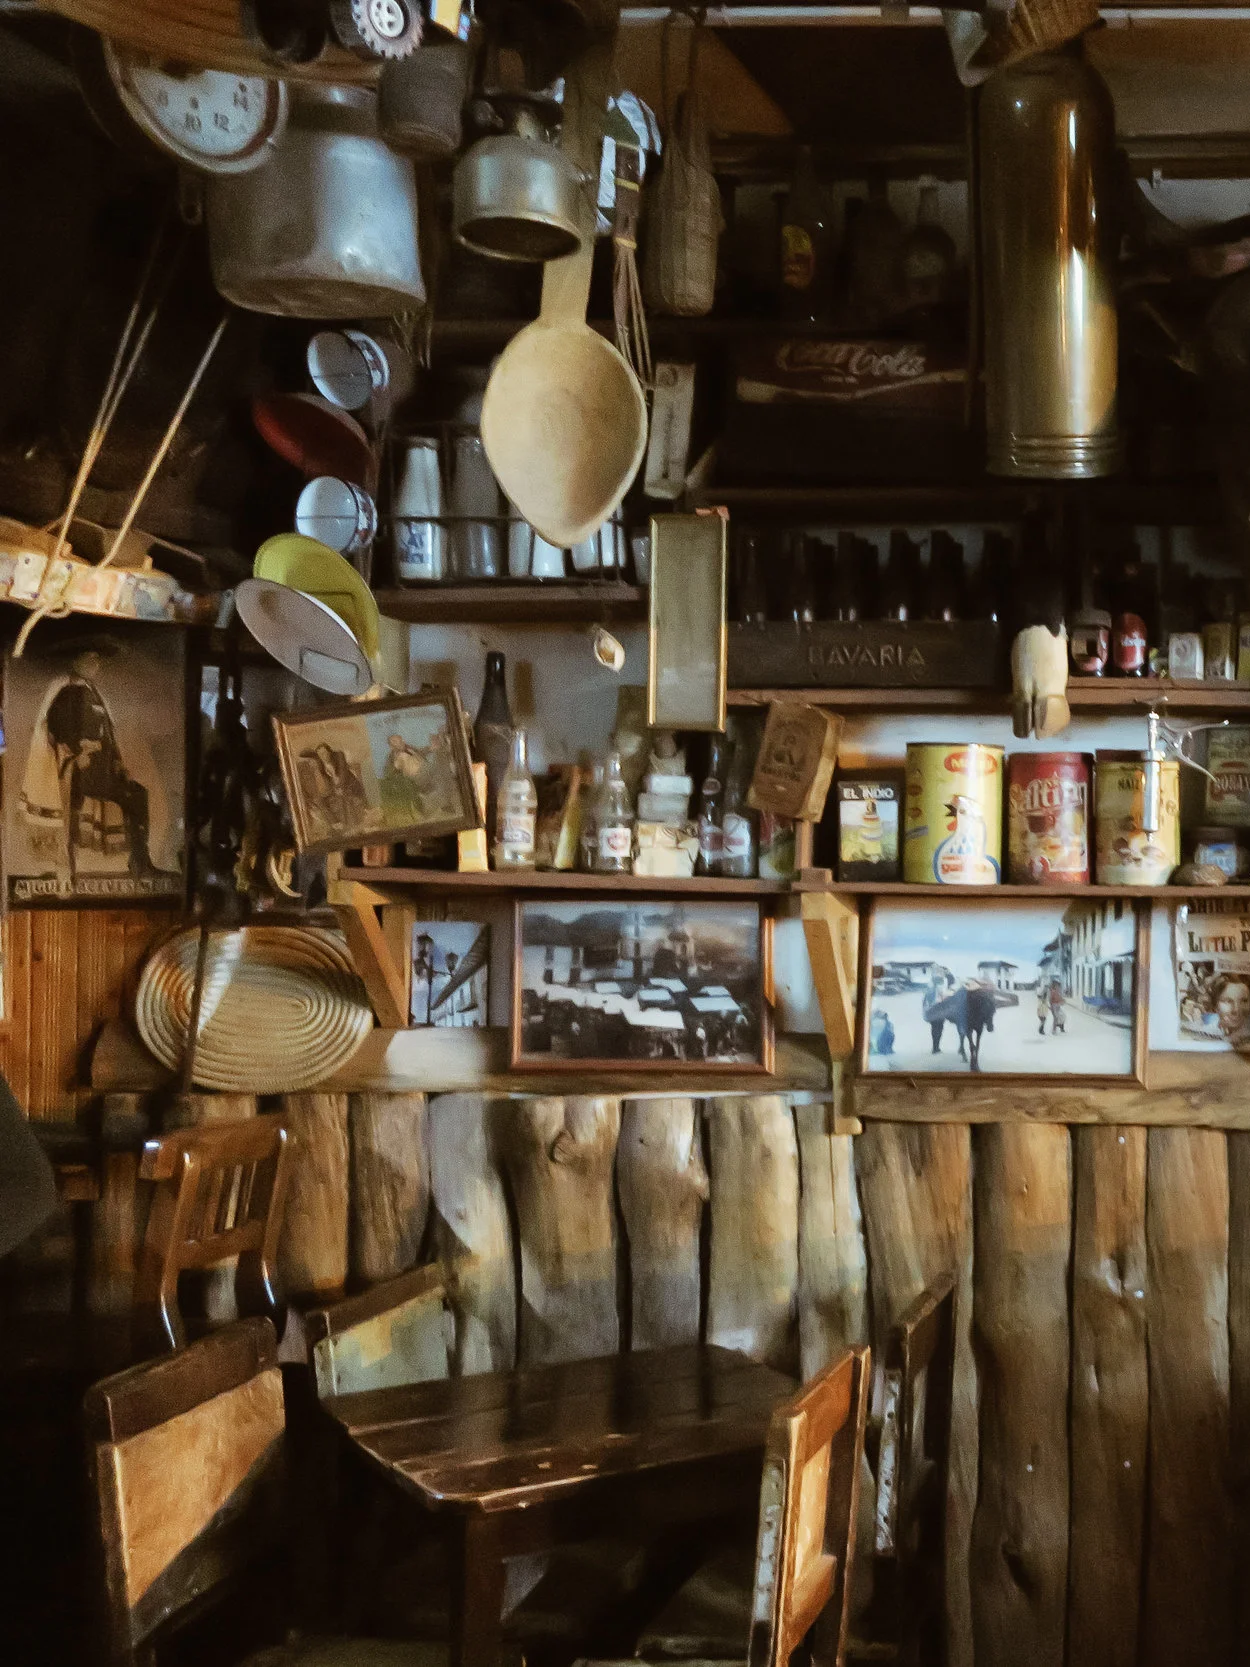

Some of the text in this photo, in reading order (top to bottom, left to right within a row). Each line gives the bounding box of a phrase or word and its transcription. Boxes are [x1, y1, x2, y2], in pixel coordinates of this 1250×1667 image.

[808, 645, 926, 666] BAVARIA
[843, 787, 894, 800] EL INDIO
